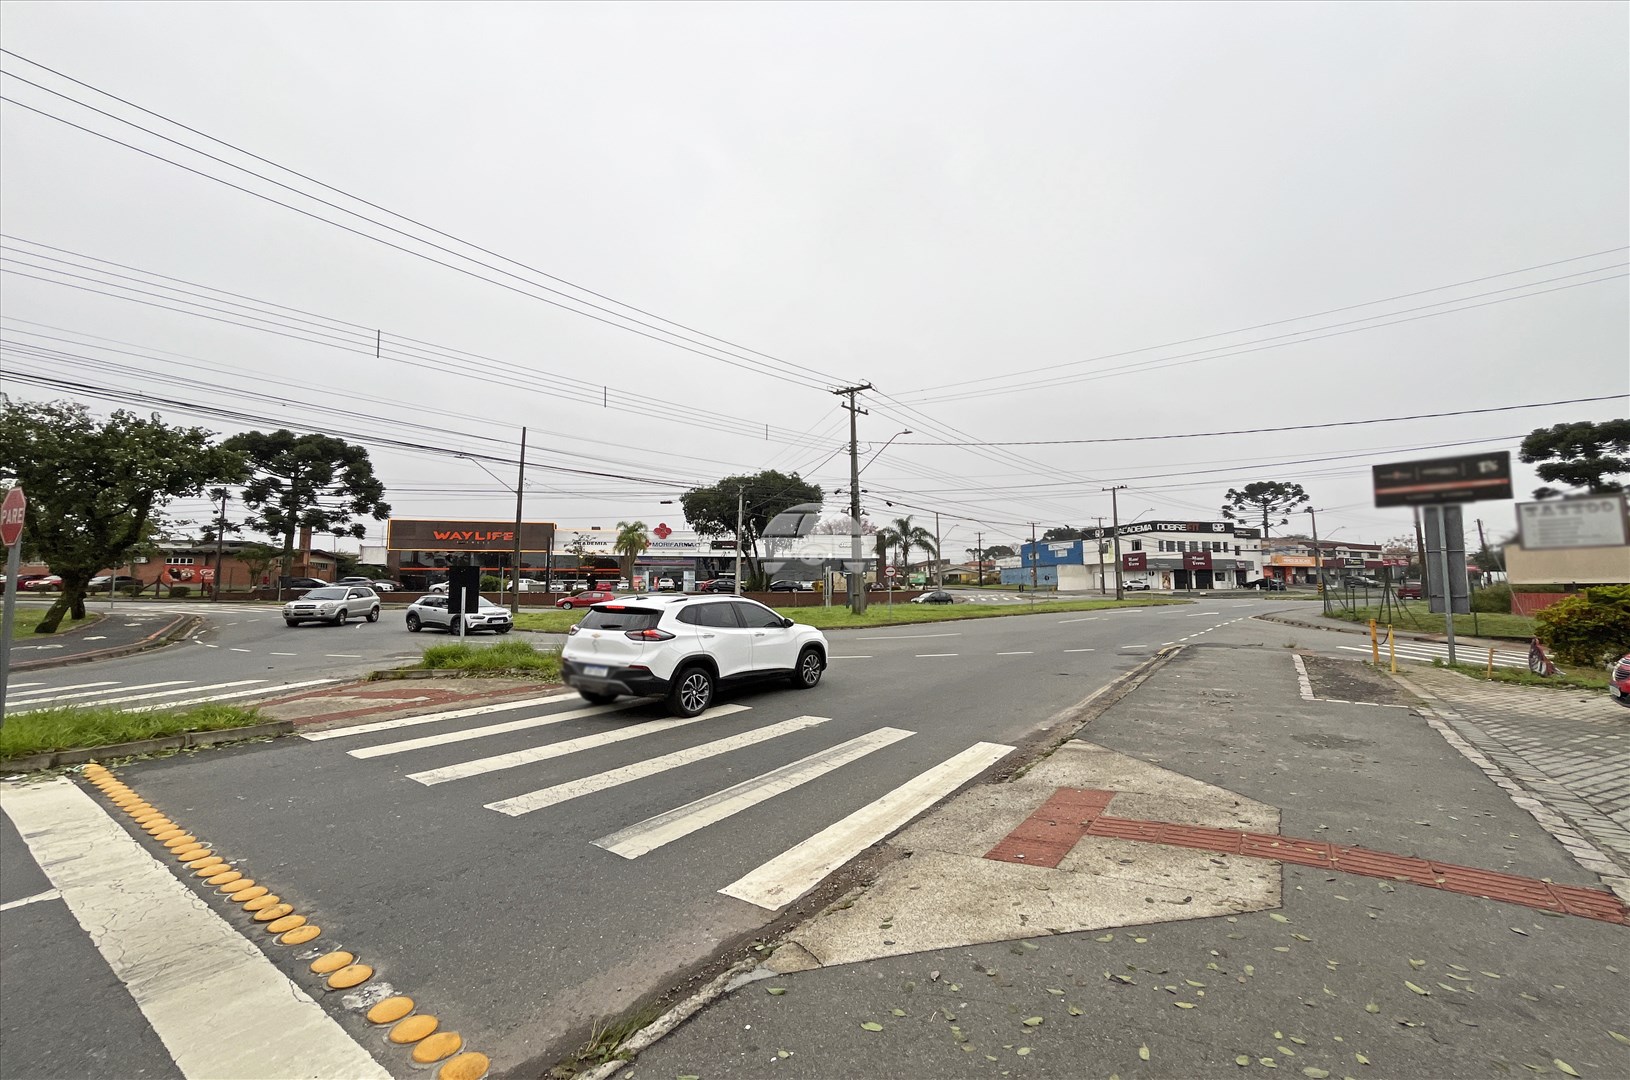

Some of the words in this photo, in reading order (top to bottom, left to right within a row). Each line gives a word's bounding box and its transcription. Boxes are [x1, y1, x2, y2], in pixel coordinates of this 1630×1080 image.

[1524, 501, 1615, 517] TATTOO
[2, 508, 24, 524] PARE
[1118, 523, 1152, 534] ACADEMIA
[433, 531, 514, 541] WAYLIFE
